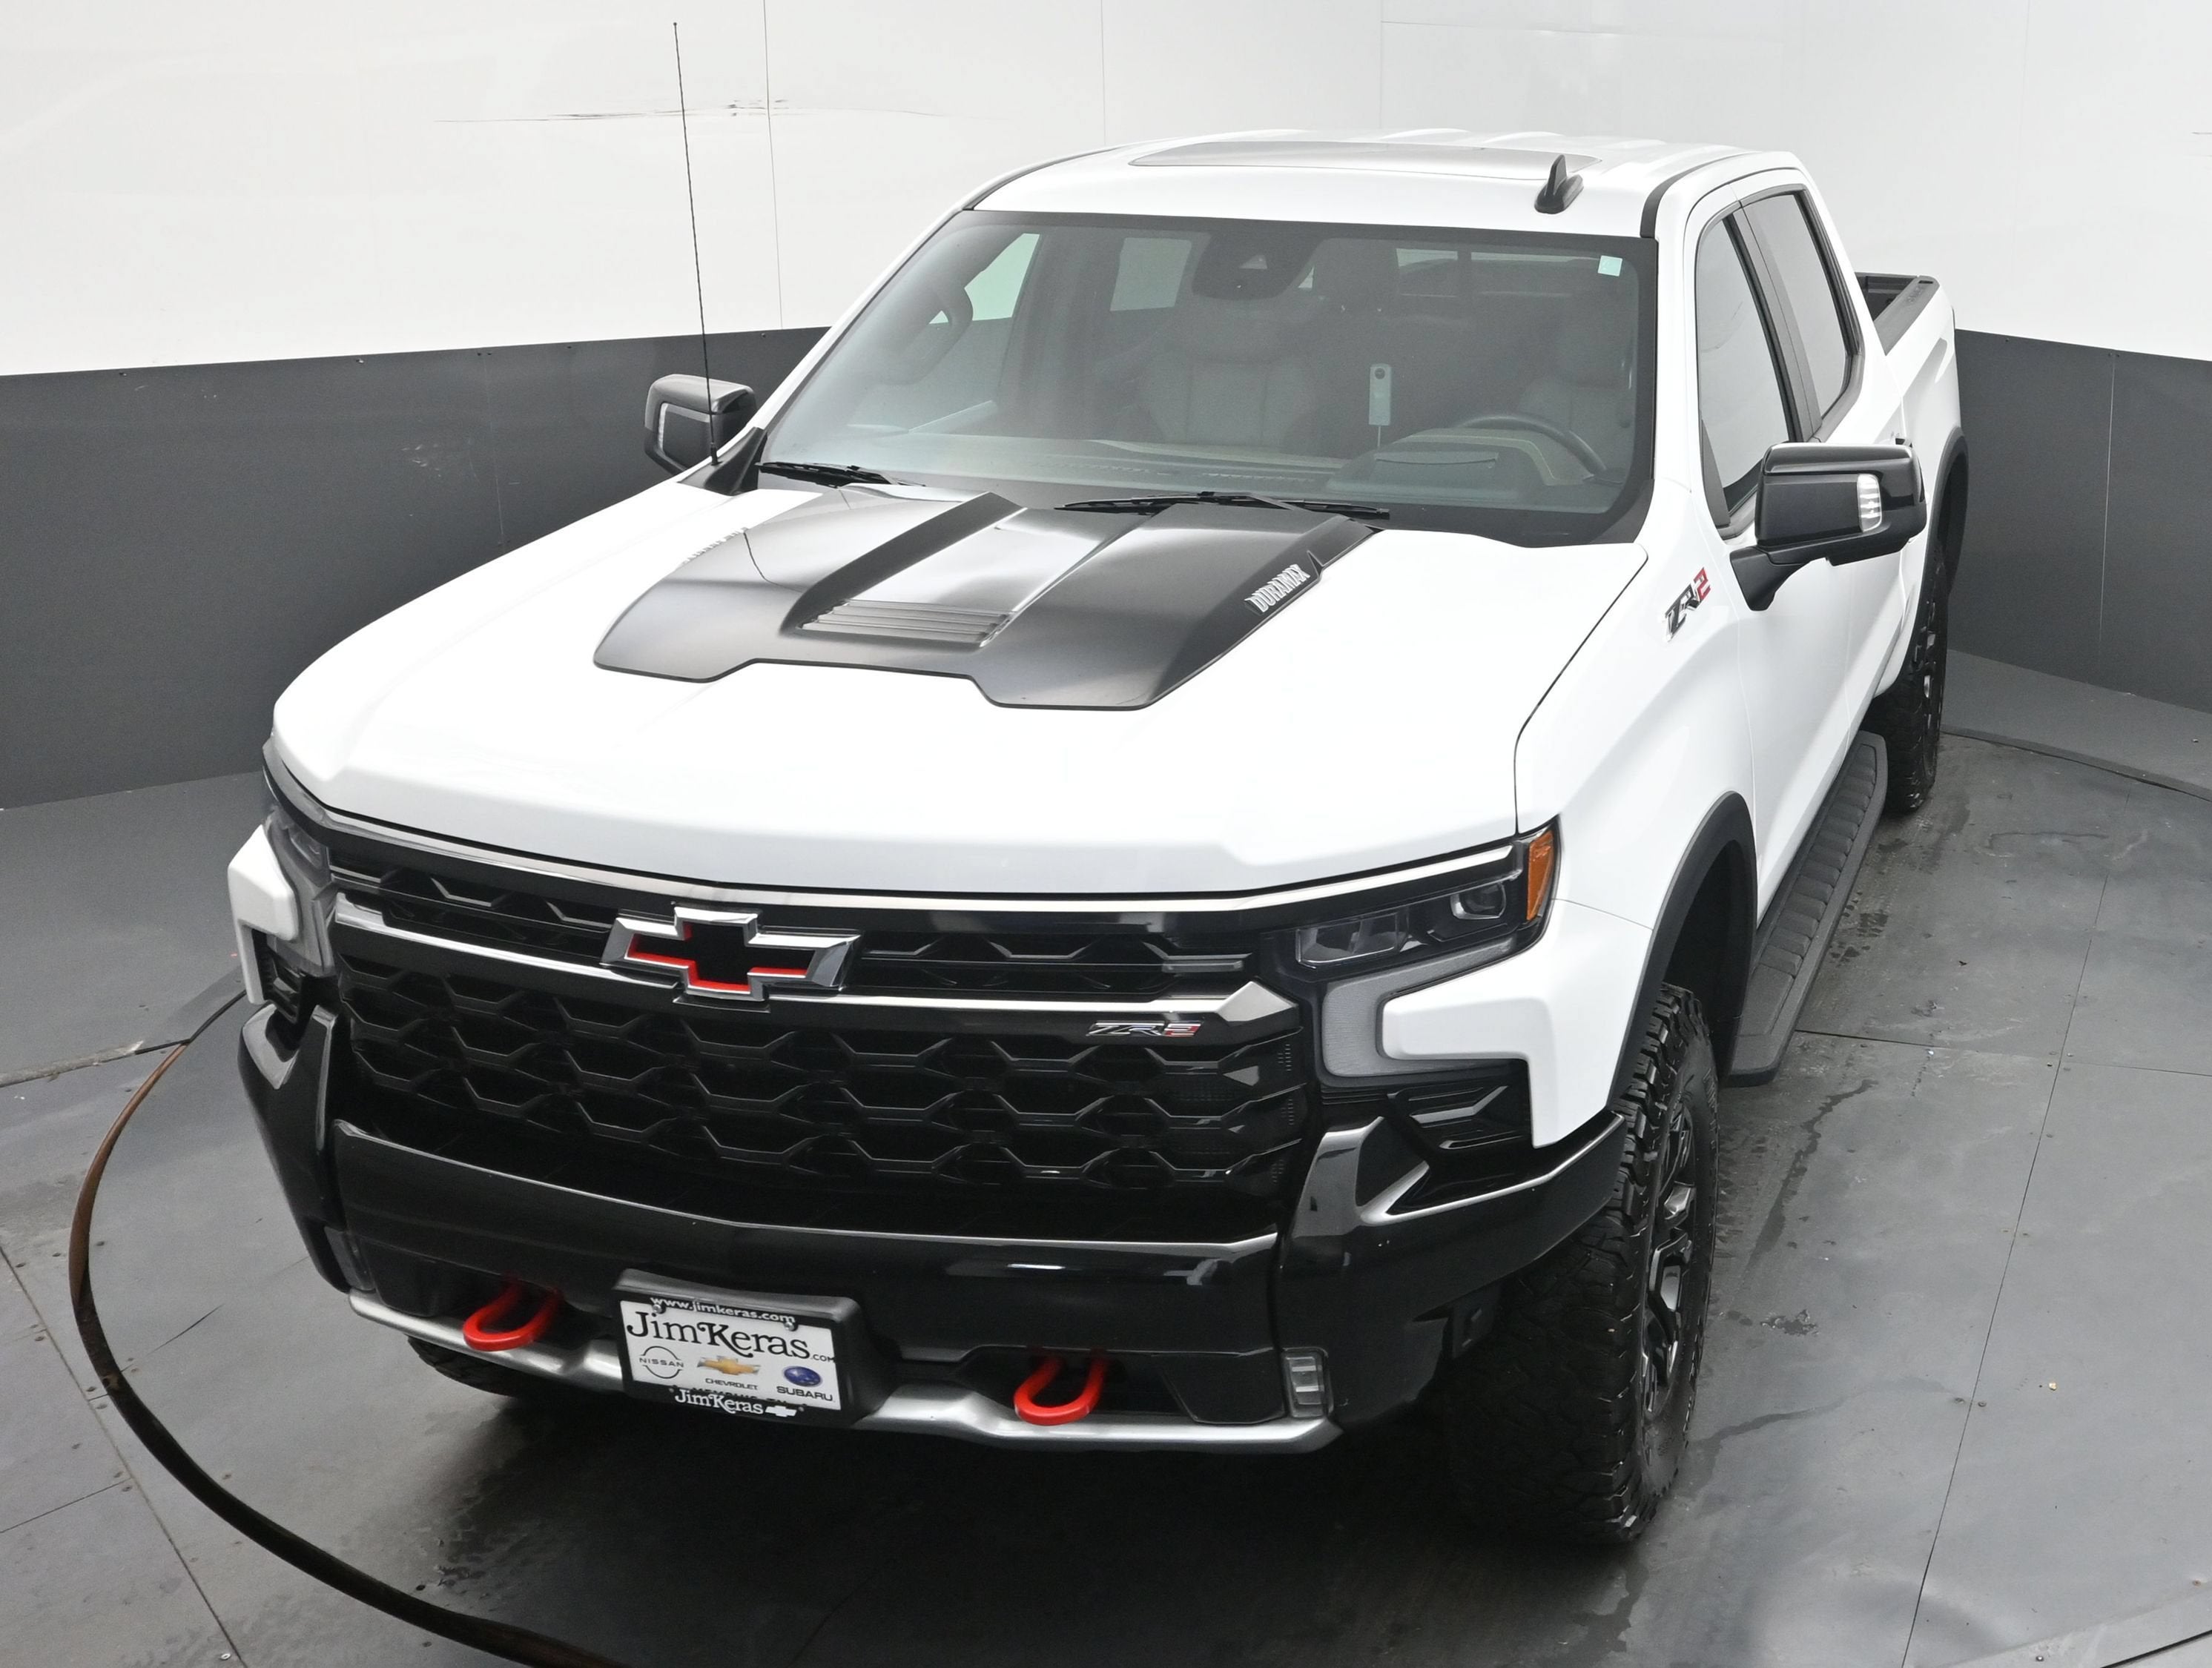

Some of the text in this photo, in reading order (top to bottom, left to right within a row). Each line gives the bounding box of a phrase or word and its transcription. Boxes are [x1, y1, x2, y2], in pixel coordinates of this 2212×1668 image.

[1244, 563, 1310, 612] DURAMAX
[1664, 566, 1711, 639] ZR2
[1086, 1021, 1201, 1037] ZR2
[650, 1297, 796, 1323] www.jimkeras.com
[639, 1357, 684, 1368] NISSAN
[704, 1377, 758, 1391] CHEVROLET
[776, 1386, 833, 1401] SUBARU
